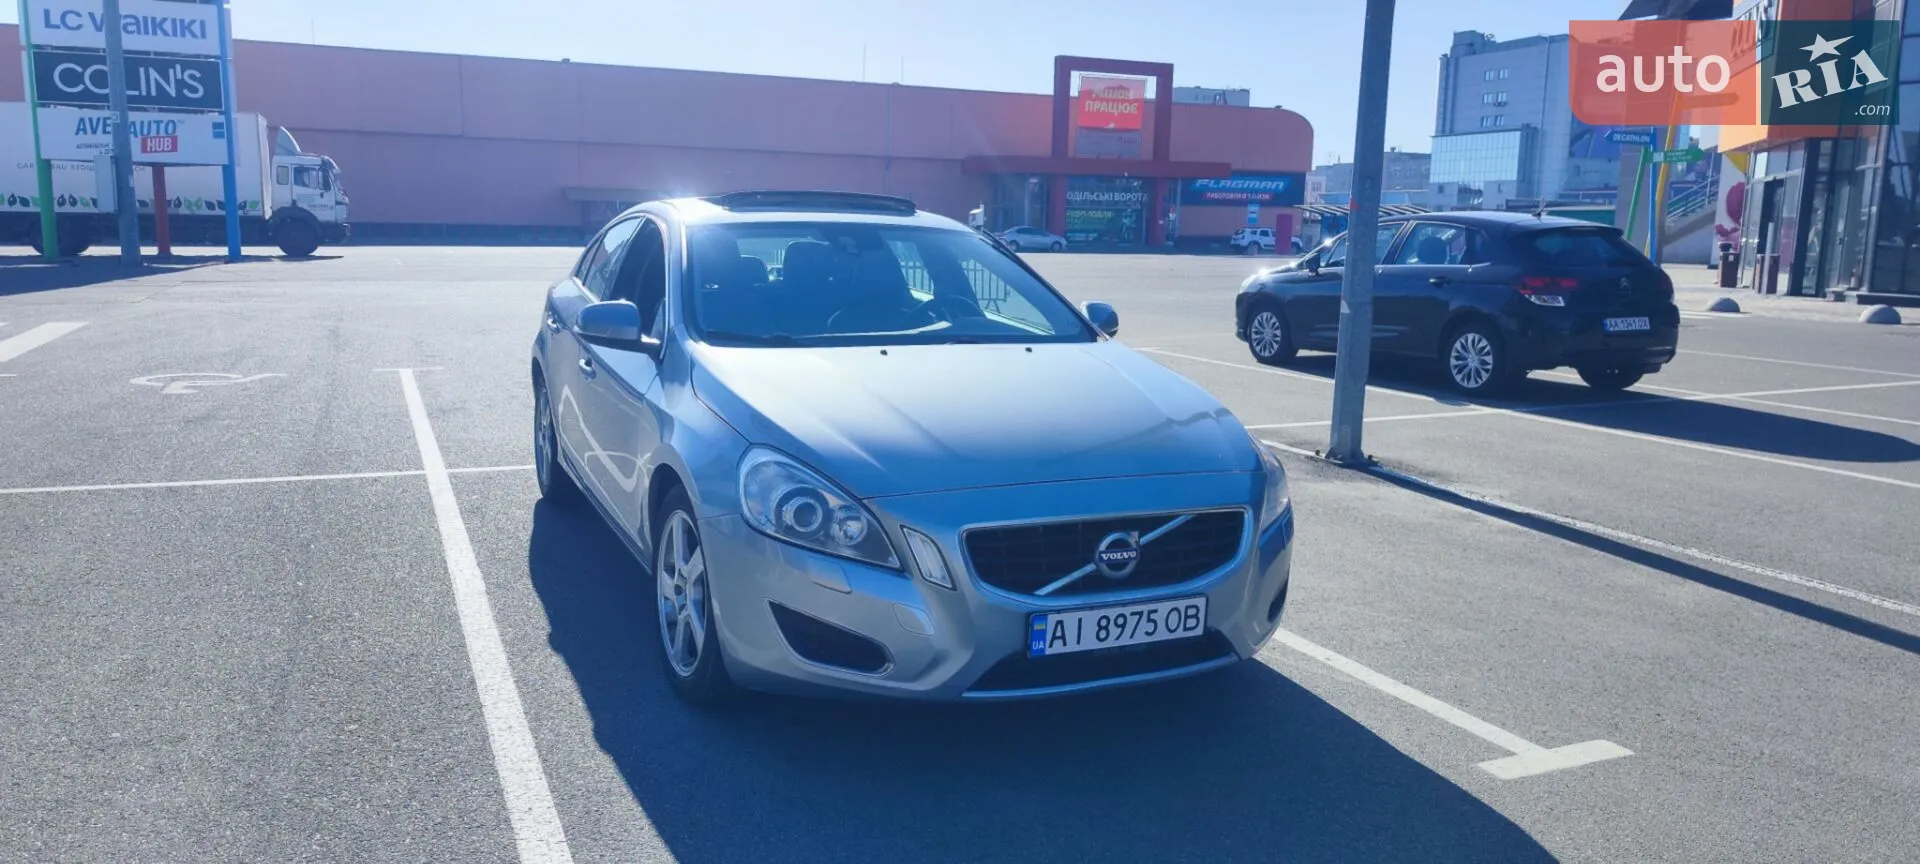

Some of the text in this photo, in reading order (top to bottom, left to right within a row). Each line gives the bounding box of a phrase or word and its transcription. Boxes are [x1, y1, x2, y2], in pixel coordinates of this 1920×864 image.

[43, 9, 83, 31] LC
[146, 137, 172, 152] HUB
[1195, 178, 1285, 190] FLAGMAN
[1066, 191, 1113, 201] ОДІЛЬСЬКІ
[1101, 551, 1137, 560] VOLVO
[1048, 604, 1201, 648] AI 8975 OB
[1032, 641, 1045, 650] UA
